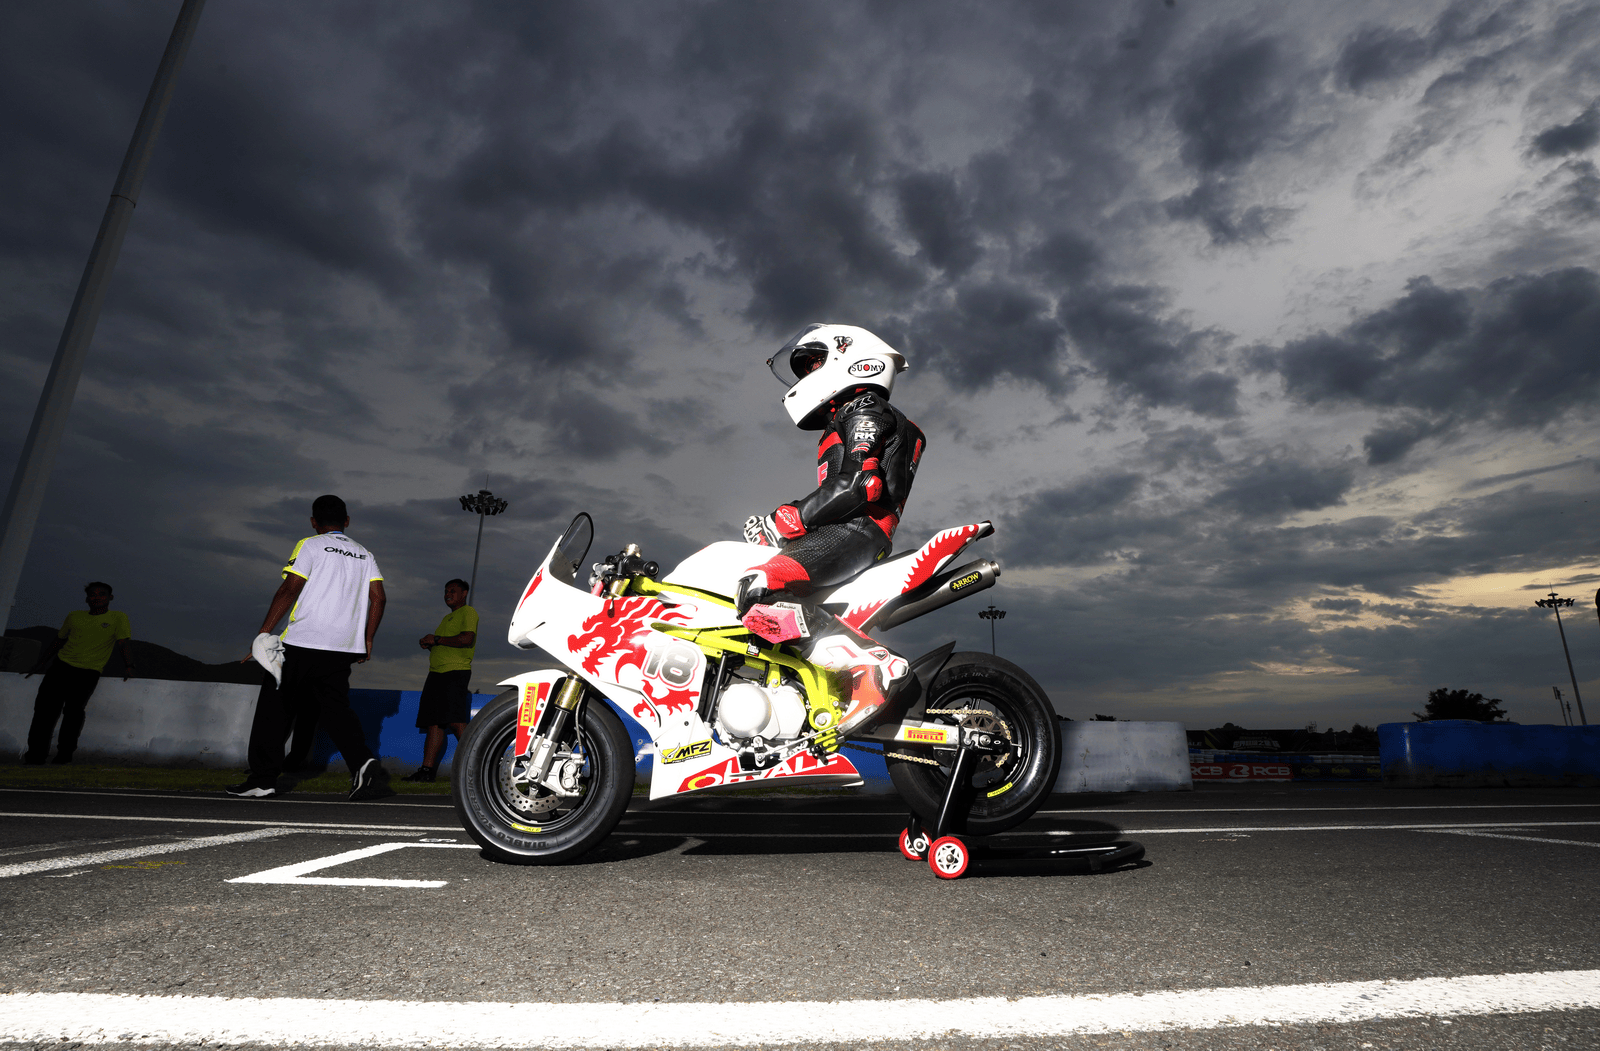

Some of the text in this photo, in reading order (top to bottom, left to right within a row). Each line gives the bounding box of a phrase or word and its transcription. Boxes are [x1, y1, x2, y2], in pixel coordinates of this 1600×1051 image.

[851, 364, 883, 372] SUOMY
[854, 432, 876, 440] RK
[324, 546, 366, 560] OHVALE
[952, 572, 979, 590] ARROW
[643, 642, 699, 689] 18
[523, 686, 537, 724] PIRELLI
[908, 729, 944, 741] PIRELLI
[675, 741, 711, 758] MFZ
[1252, 766, 1291, 775] RCB
[467, 768, 548, 849] DIABLO SUPERBIKE
